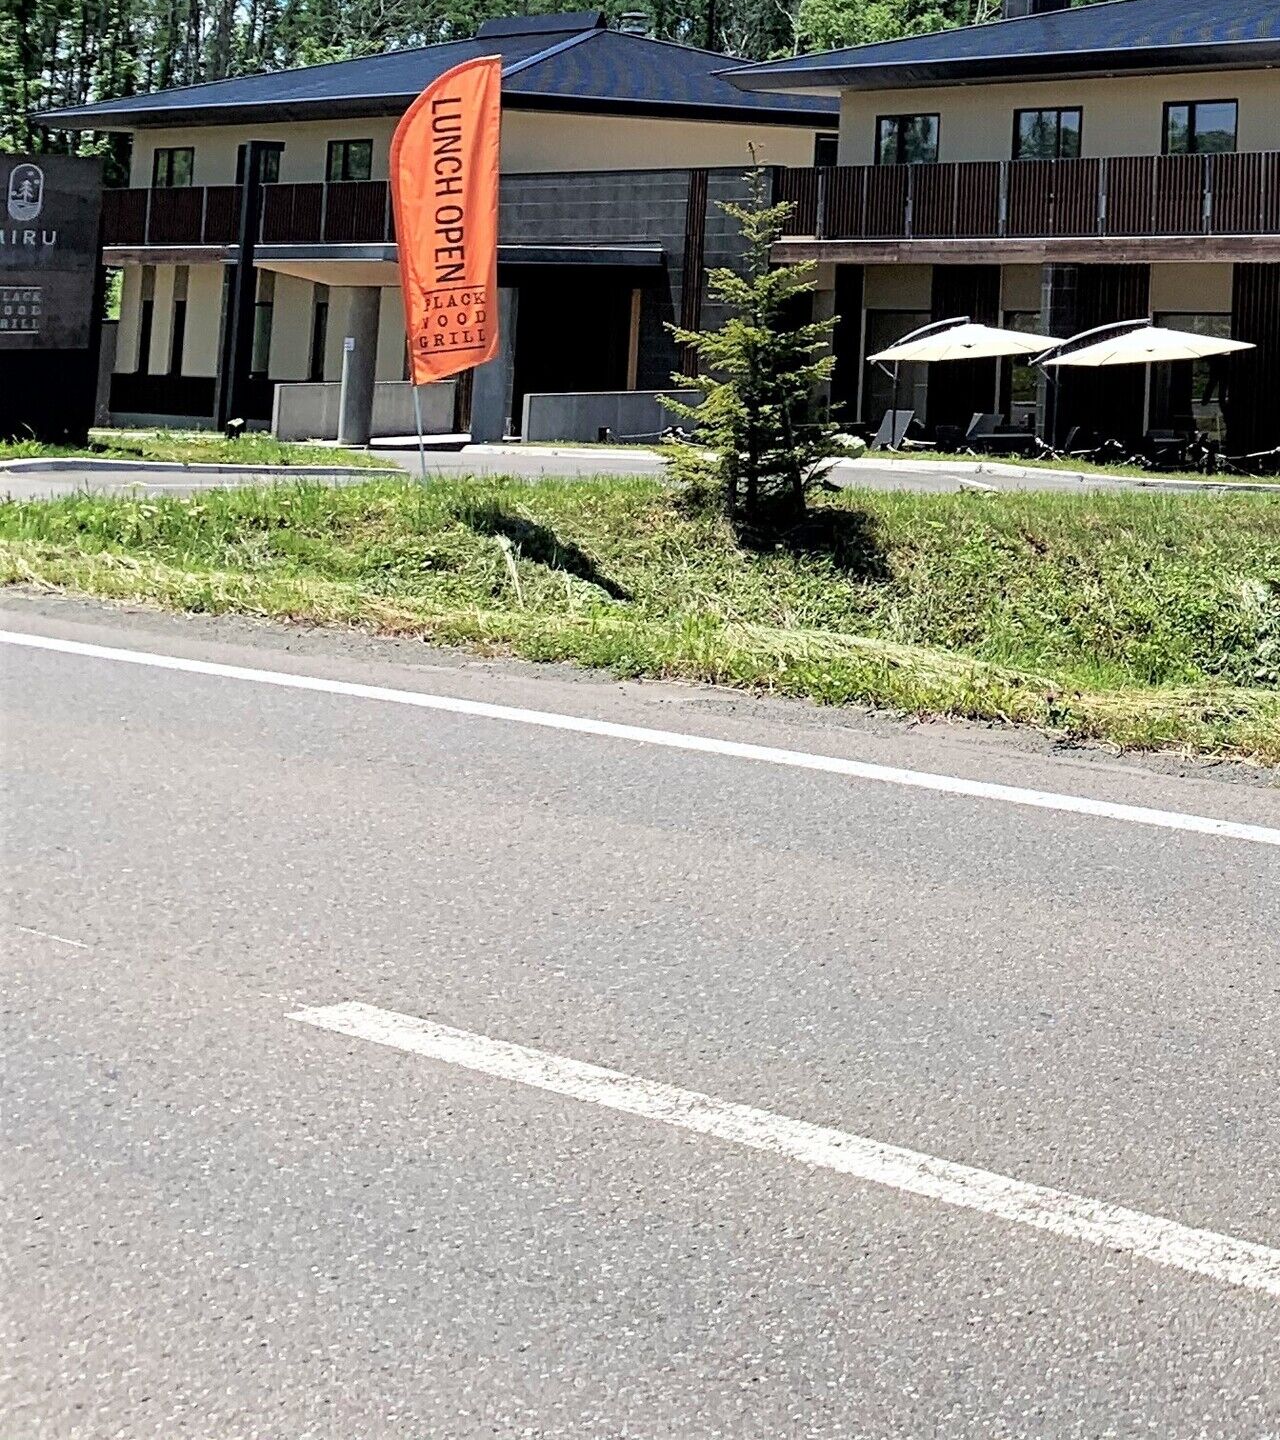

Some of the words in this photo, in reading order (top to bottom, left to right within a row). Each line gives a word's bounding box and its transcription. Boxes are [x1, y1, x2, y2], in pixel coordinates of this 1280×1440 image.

[431, 97, 463, 198] LUNCH
[434, 205, 466, 284] OPEN
[0, 318, 40, 329] RILL
[419, 329, 487, 349] GRILL
